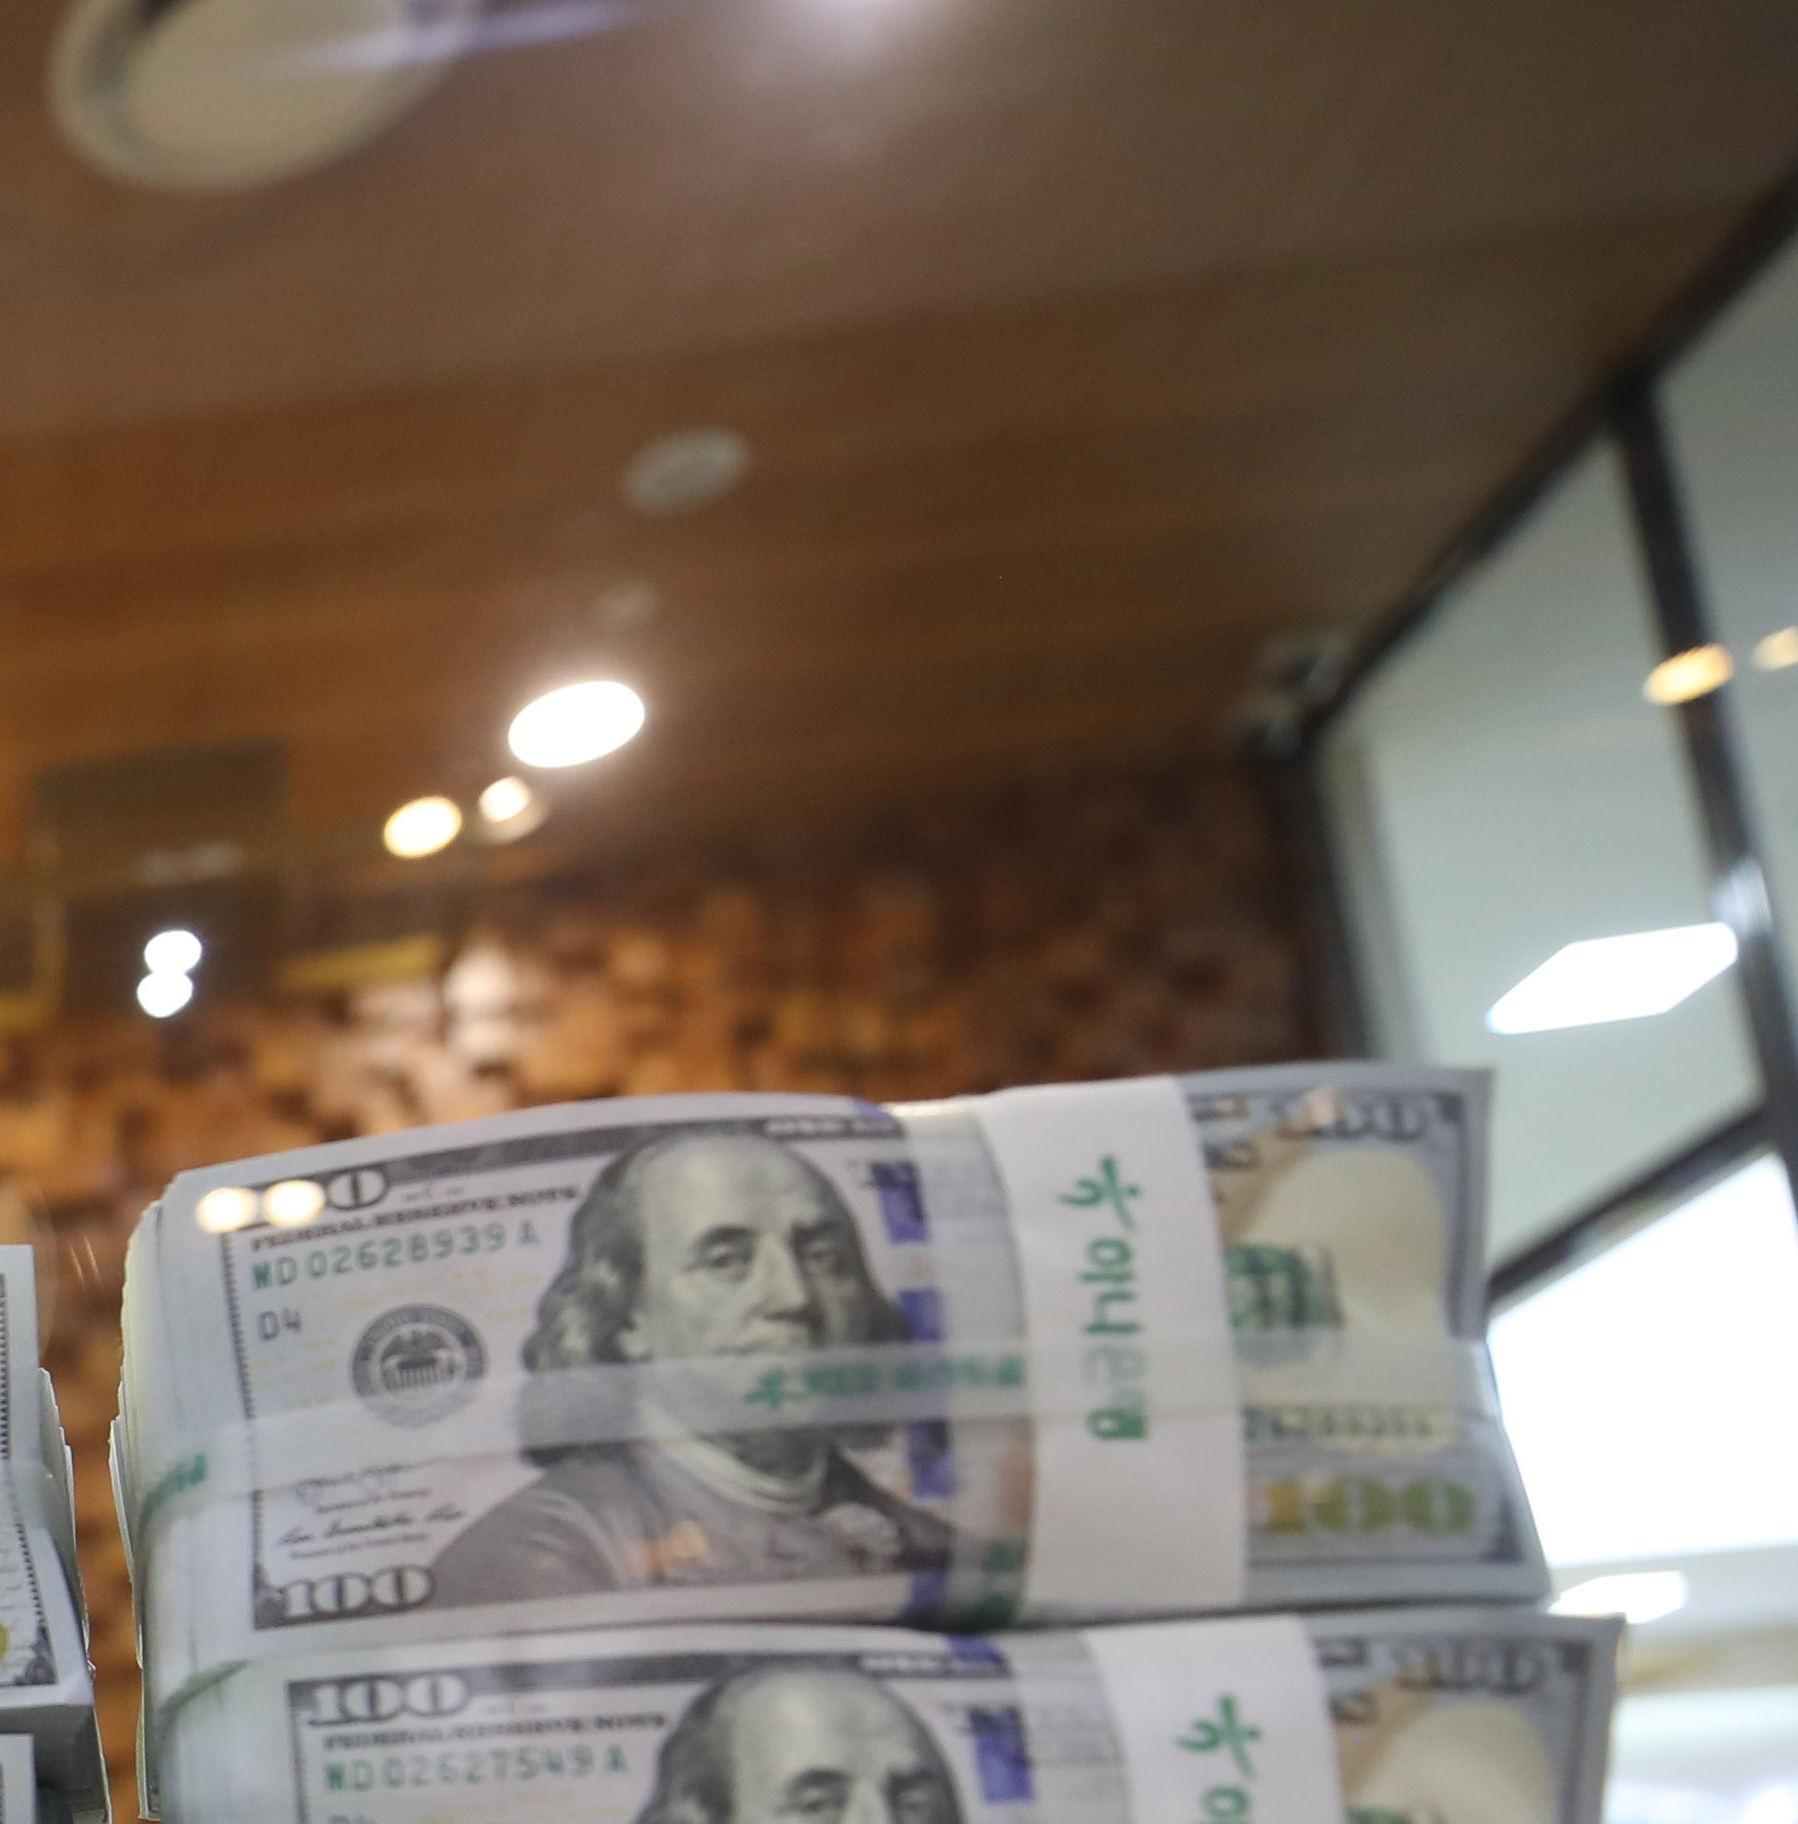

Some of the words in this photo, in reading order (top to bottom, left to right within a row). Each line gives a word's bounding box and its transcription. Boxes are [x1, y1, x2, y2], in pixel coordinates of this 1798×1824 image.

[309, 1227, 505, 1277] 02628939
[1266, 1475, 1474, 1536] 100
[280, 1562, 435, 1618] 100
[305, 1674, 470, 1728] 100
[385, 1747, 595, 1789] 02627549
